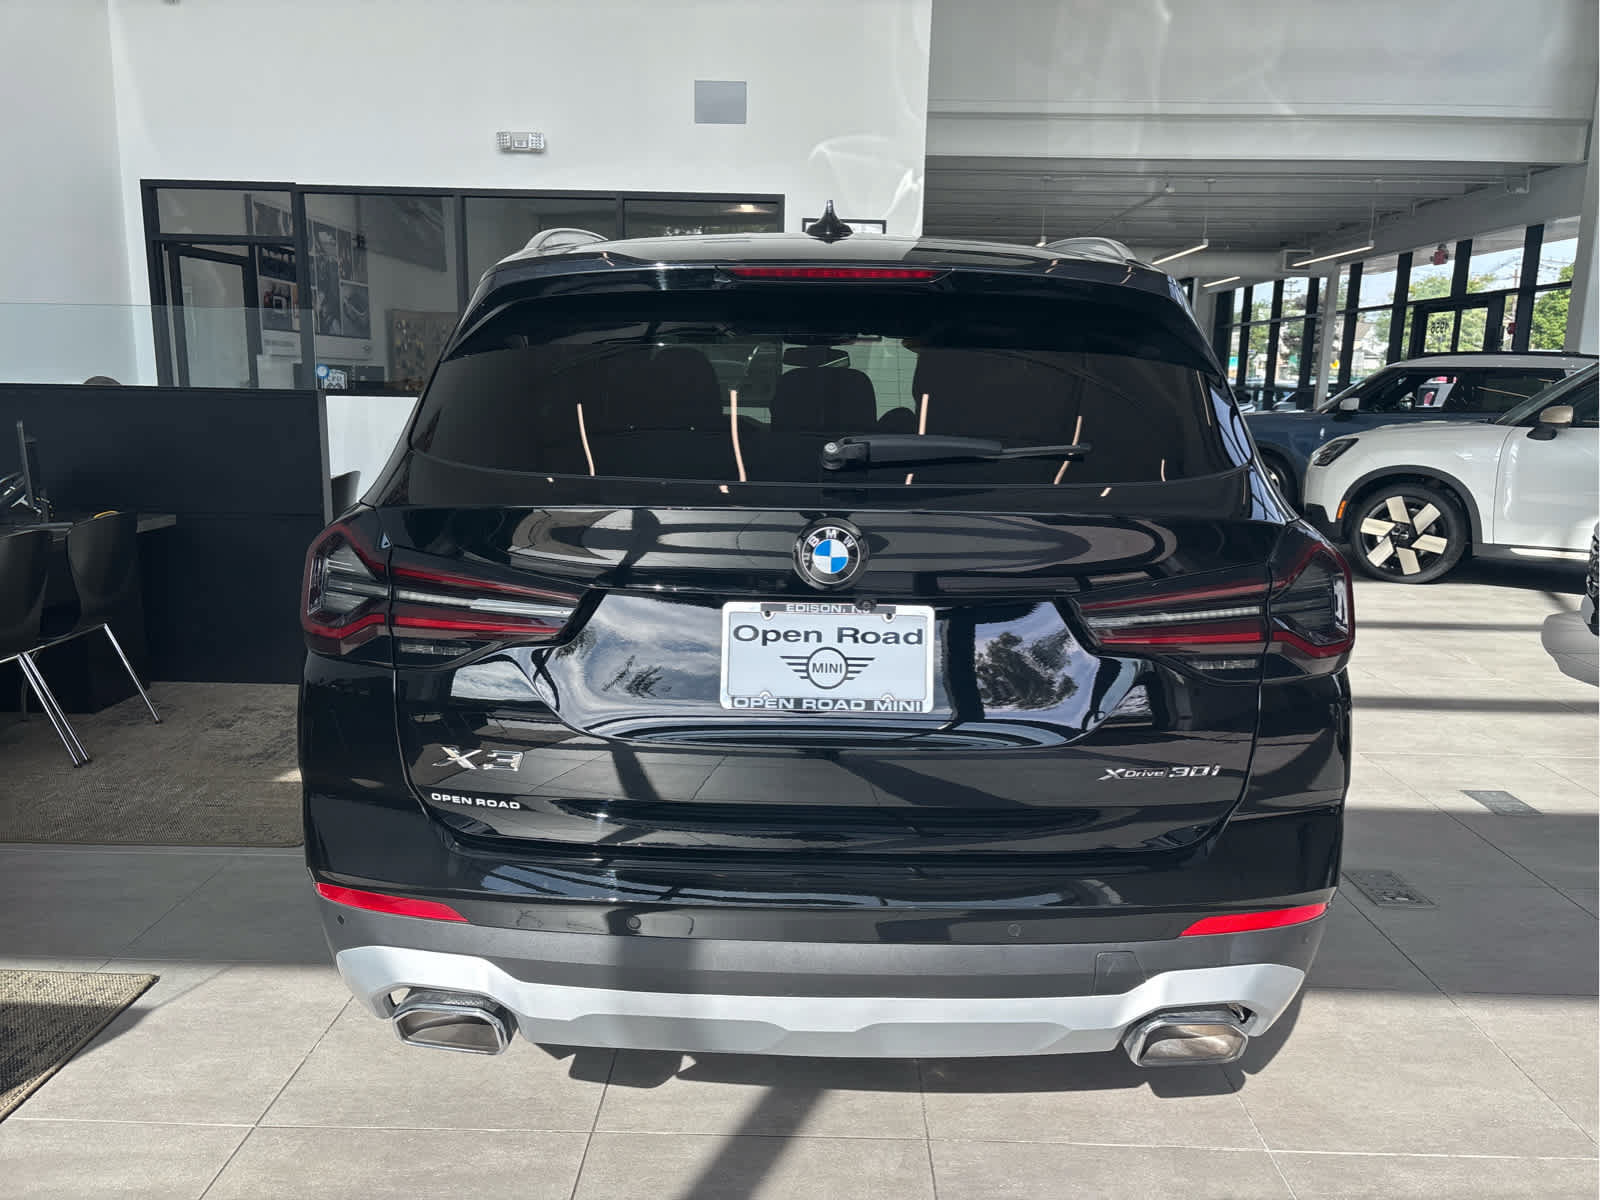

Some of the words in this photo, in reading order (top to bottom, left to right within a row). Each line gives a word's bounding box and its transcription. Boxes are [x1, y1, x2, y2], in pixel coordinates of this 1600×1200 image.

[808, 529, 855, 548] BMW
[732, 624, 823, 646] Open
[837, 627, 923, 645] Road
[812, 663, 843, 674] MINI
[733, 698, 795, 710] OPEN
[802, 699, 865, 711] ROAD
[873, 700, 921, 712] MINI
[432, 746, 523, 772] X3
[431, 793, 472, 805] OPEN
[475, 798, 520, 809] ROAD
